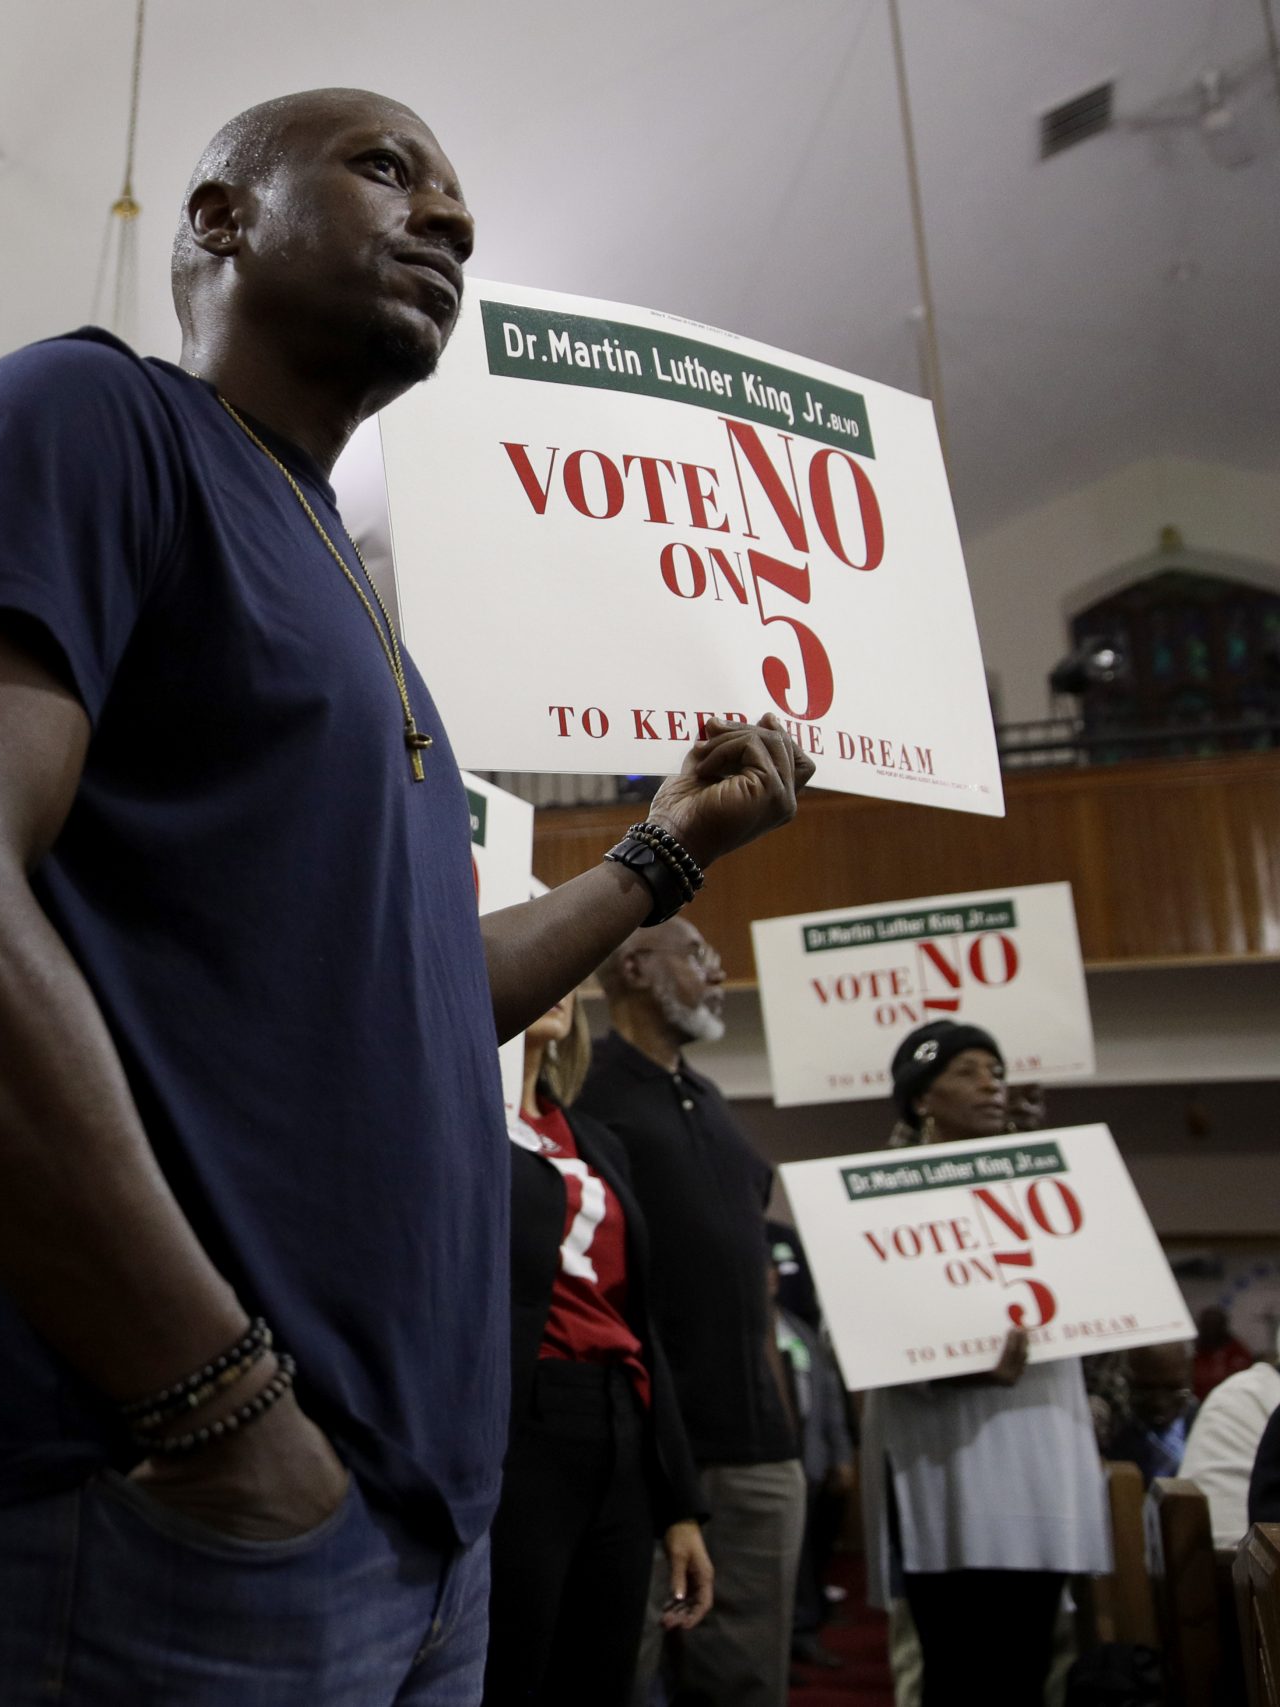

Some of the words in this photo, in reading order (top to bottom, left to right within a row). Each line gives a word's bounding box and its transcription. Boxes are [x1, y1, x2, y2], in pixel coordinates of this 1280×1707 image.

[652, 346, 733, 399] Luther
[741, 371, 794, 425] King
[499, 441, 731, 534] VOTE
[717, 416, 885, 572] NO
[659, 542, 749, 605] ON
[747, 548, 834, 721] 5
[548, 705, 610, 739] TO
[782, 719, 825, 756] HE
[836, 730, 937, 776] DREAM
[876, 916, 926, 939] Luther
[928, 911, 964, 932] King
[810, 966, 914, 1004] VOTE
[915, 930, 1019, 990] NO
[875, 1002, 919, 1027] ON
[923, 1161, 975, 1183] Luther
[975, 1156, 1015, 1178] King
[863, 1216, 980, 1262] VOTE
[969, 1175, 1084, 1249] NO
[943, 1257, 995, 1288] ON
[992, 1249, 1058, 1333] 5
